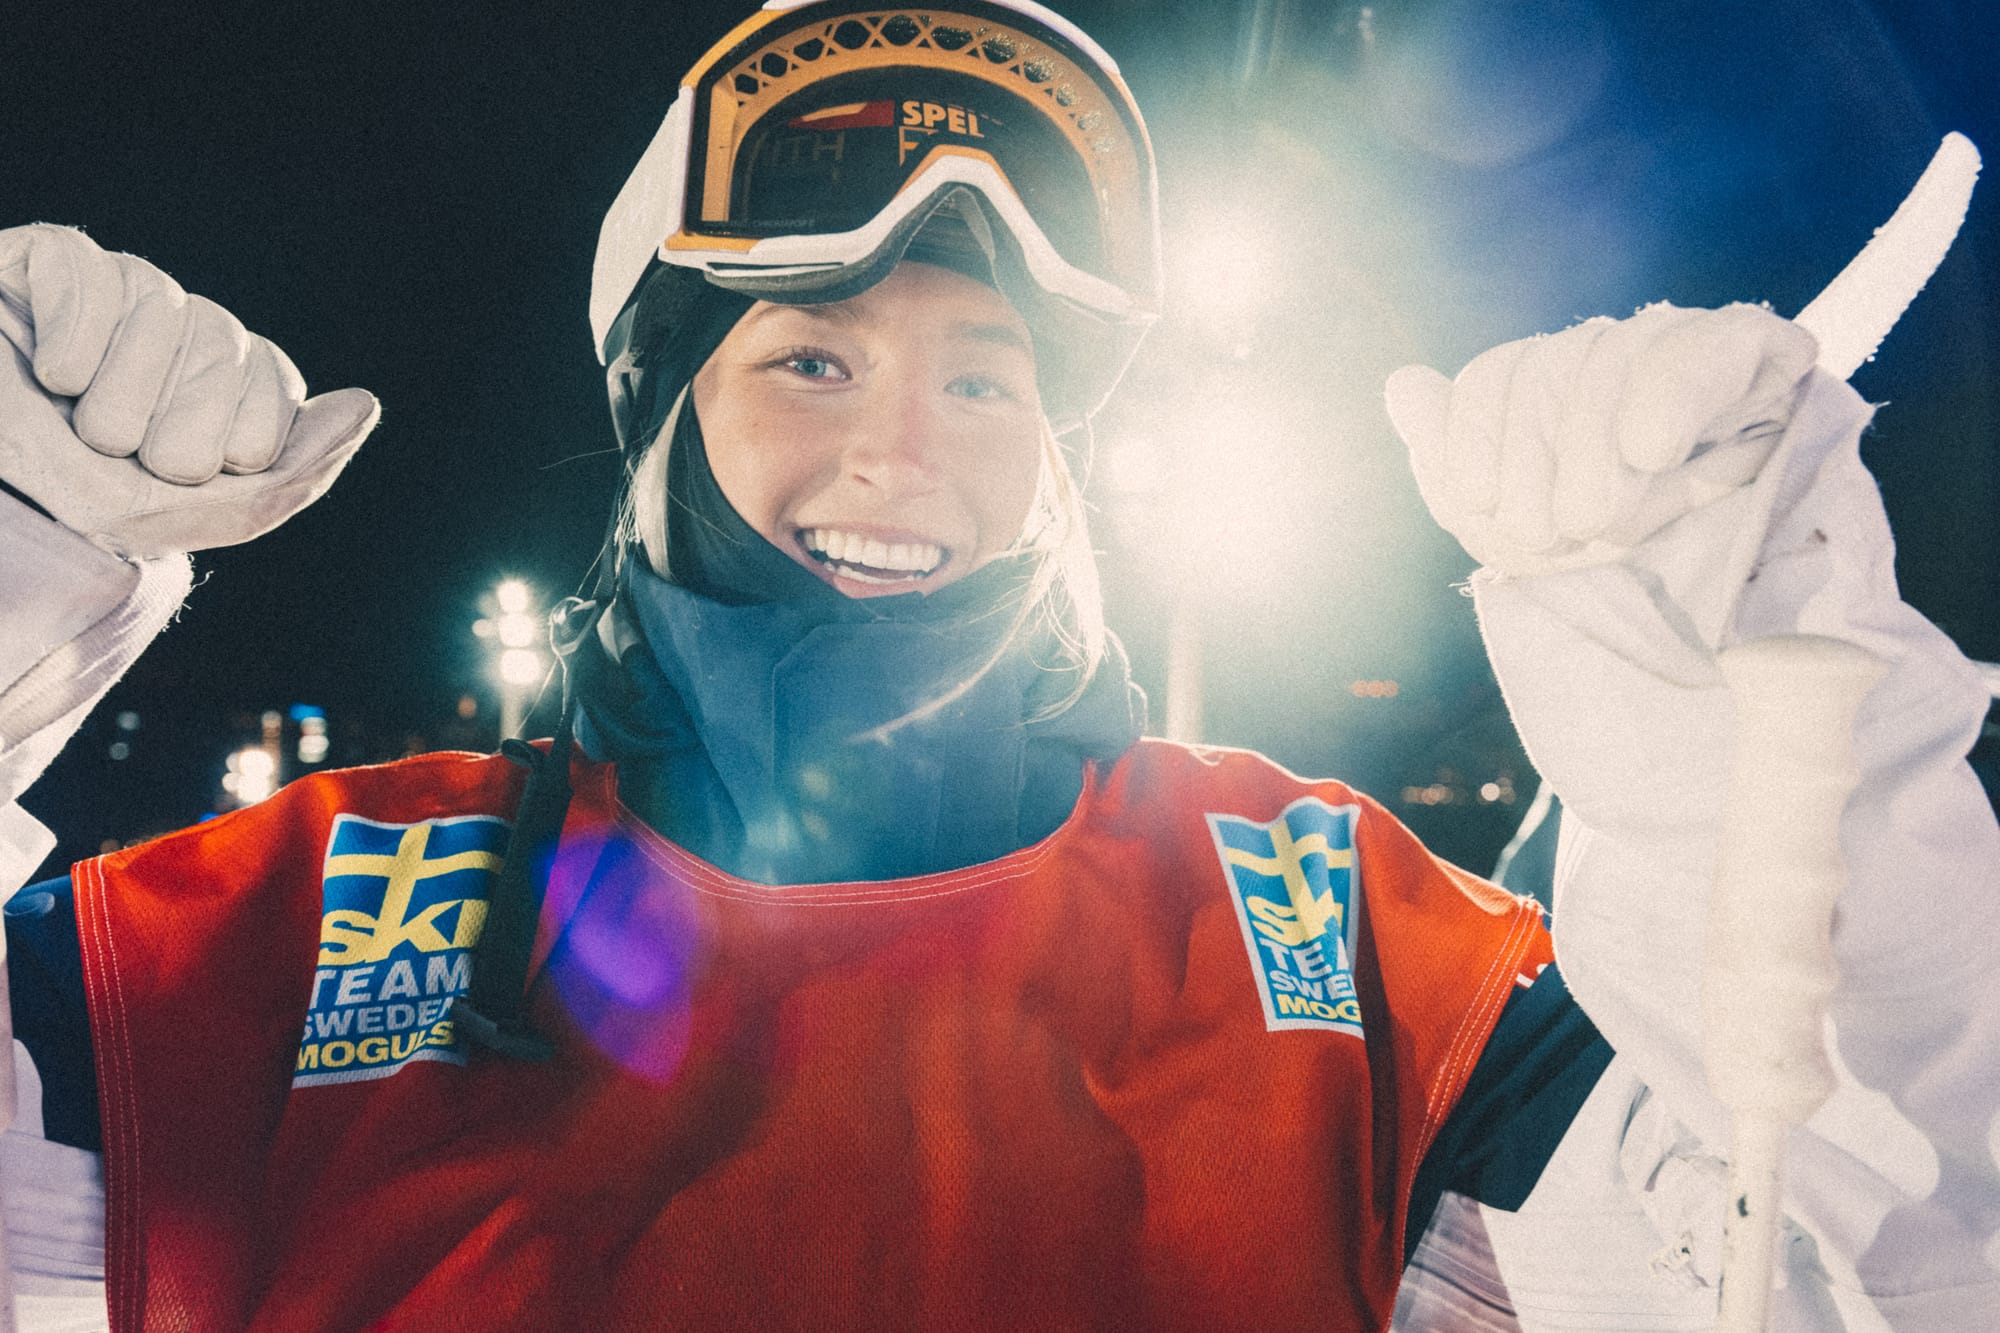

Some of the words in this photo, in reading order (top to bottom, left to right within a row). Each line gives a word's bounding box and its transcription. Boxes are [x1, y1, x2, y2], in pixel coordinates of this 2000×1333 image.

[902, 100, 985, 138] SPEL
[309, 953, 472, 1010] TEAM
[1270, 970, 1357, 1000] SWE
[296, 1021, 455, 1070] MOGULS
